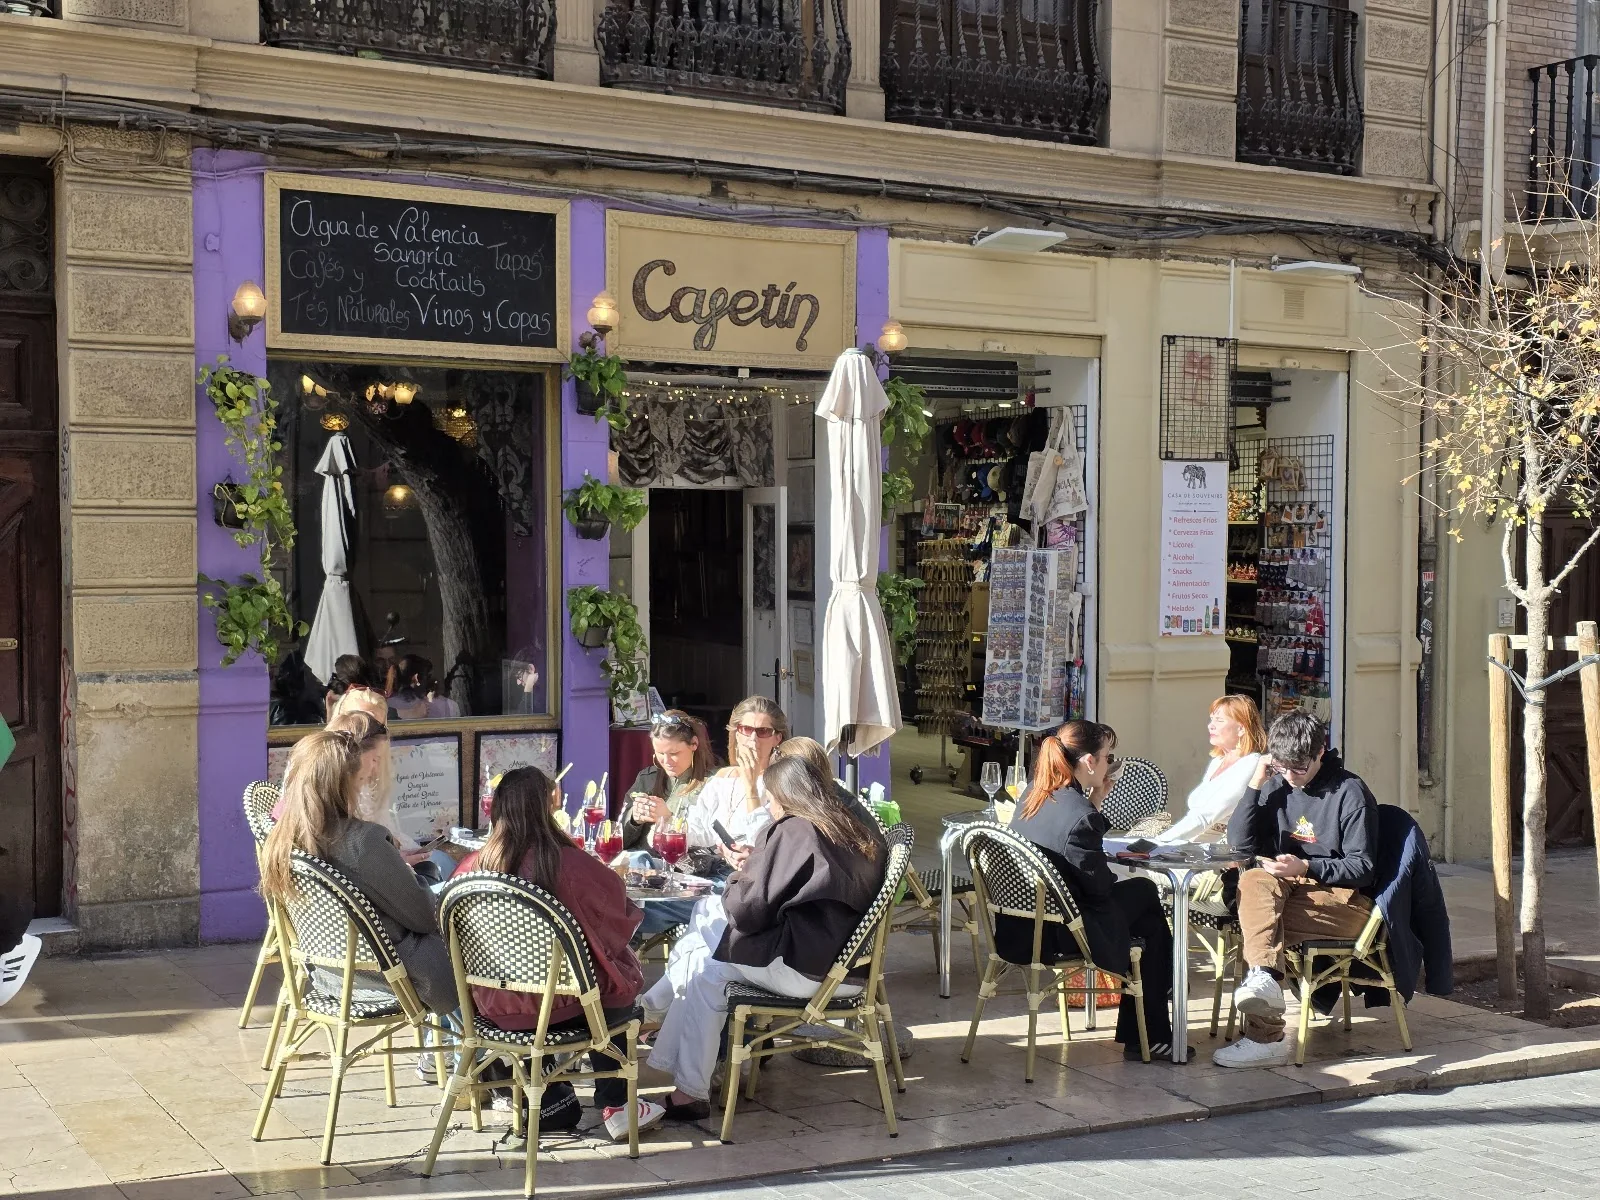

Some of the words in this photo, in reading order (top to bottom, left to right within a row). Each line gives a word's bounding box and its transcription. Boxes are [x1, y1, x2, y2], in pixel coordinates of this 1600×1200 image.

[290, 199, 351, 247] Agua
[355, 211, 379, 238] de
[388, 207, 484, 246] Valencia
[288, 249, 345, 288] Cafés
[349, 268, 364, 293] y
[374, 242, 458, 275] Sangría
[487, 242, 543, 280] Tapas
[396, 264, 486, 297] Cocktails
[410, 292, 474, 335] Vinos
[482, 309, 492, 333] y
[496, 299, 551, 343] Copas
